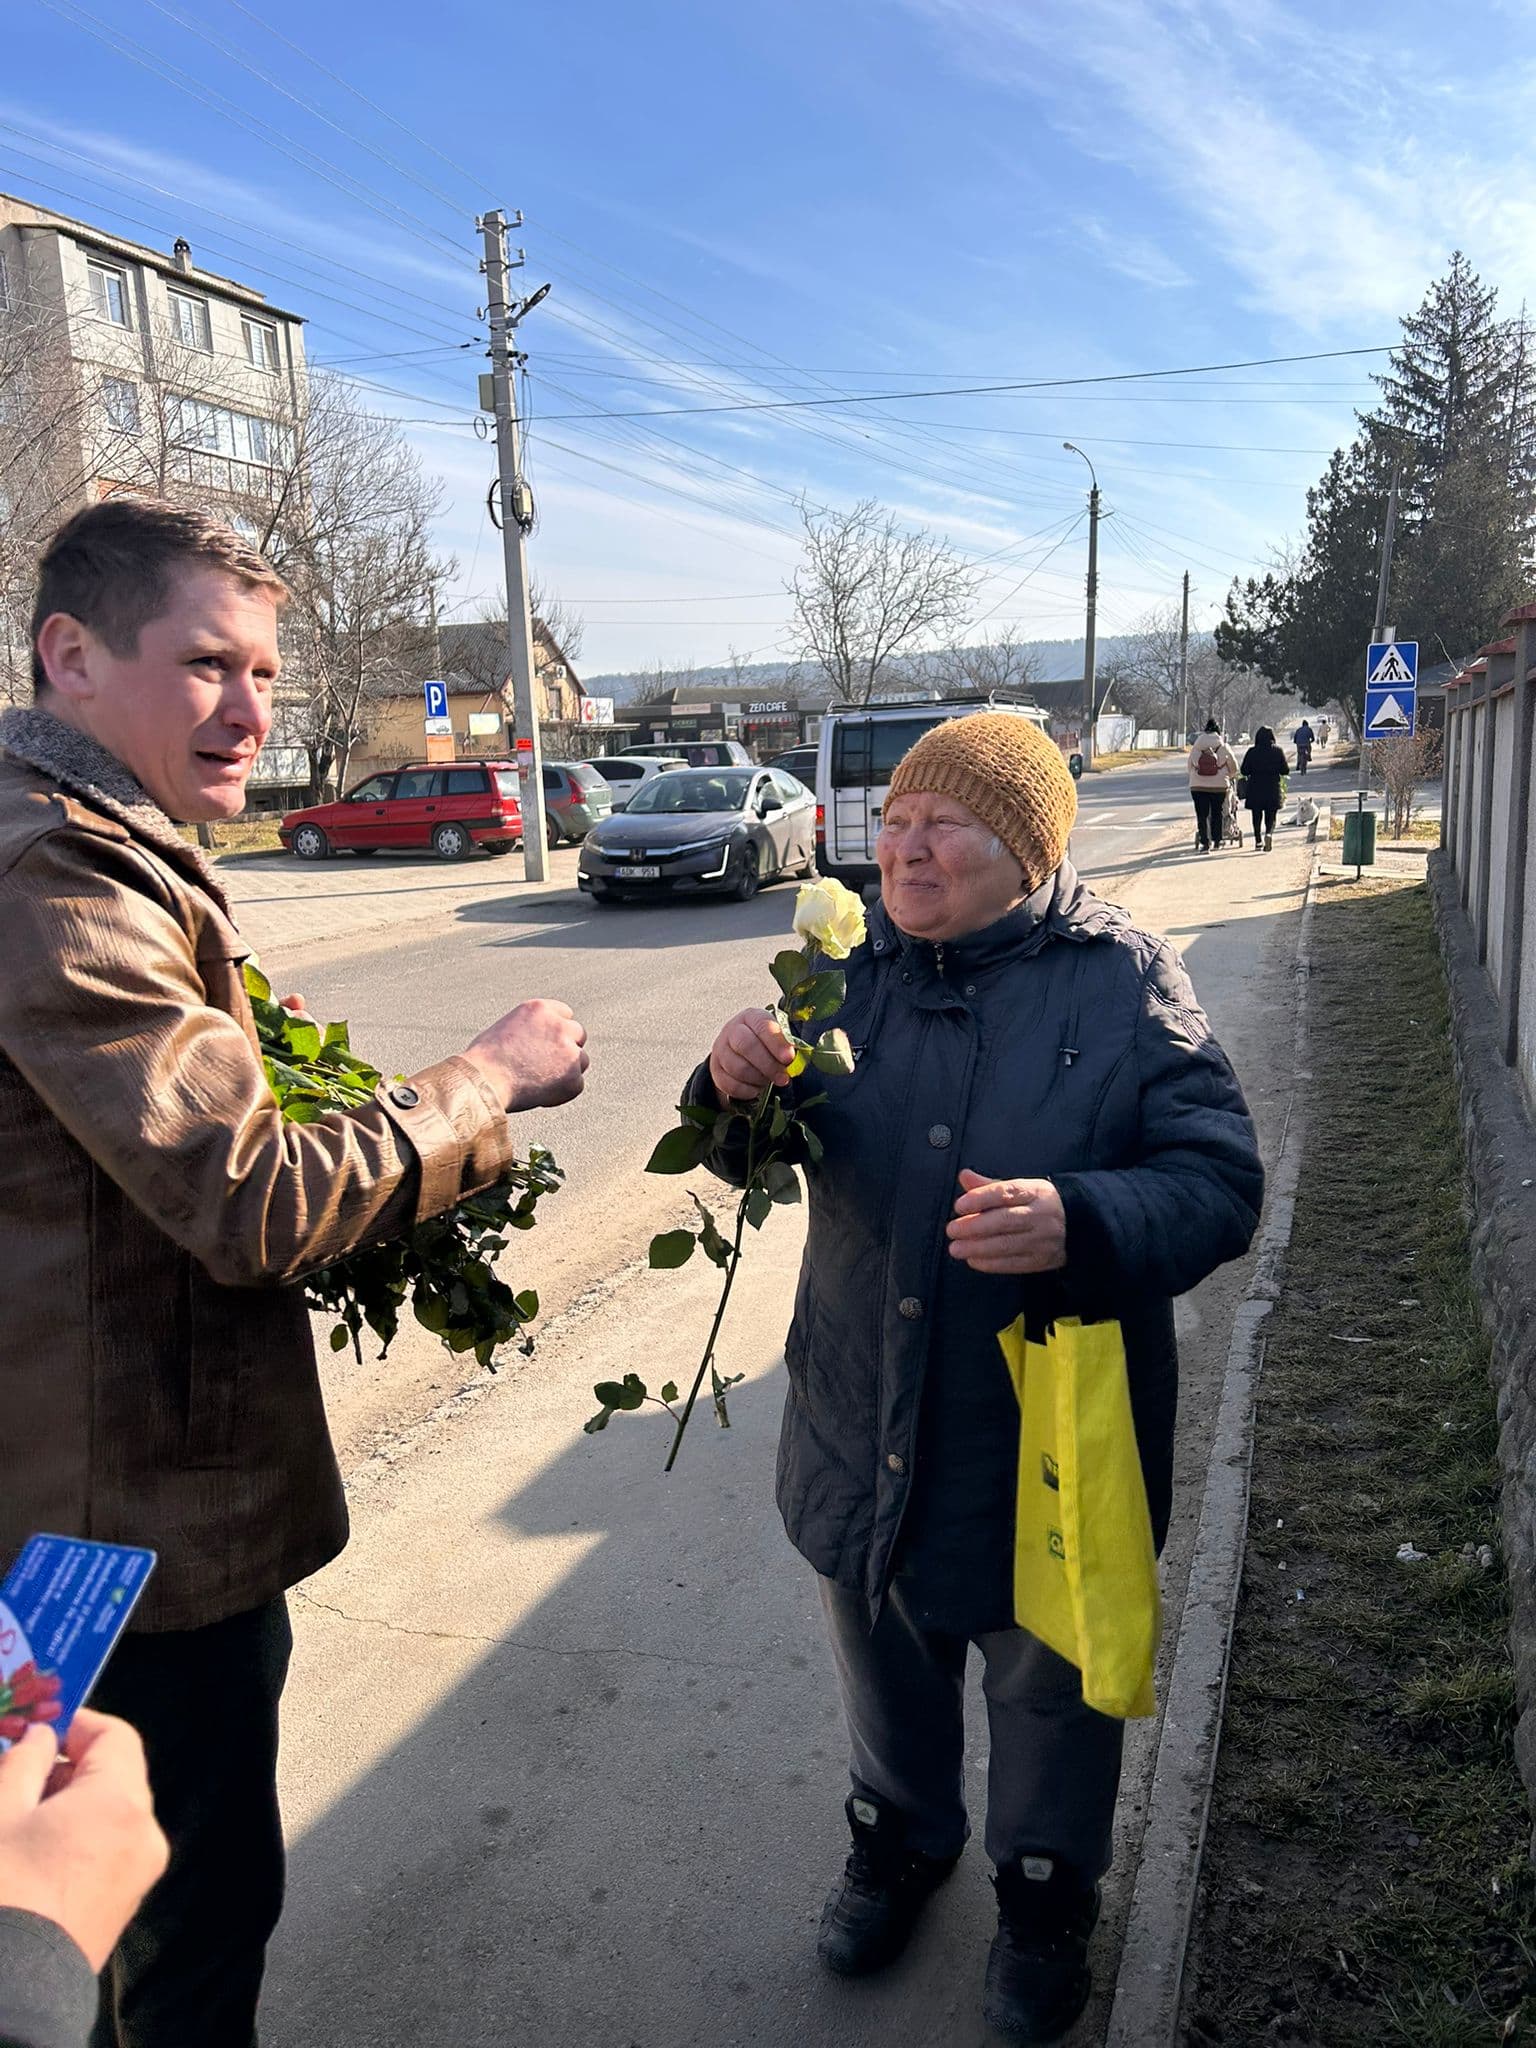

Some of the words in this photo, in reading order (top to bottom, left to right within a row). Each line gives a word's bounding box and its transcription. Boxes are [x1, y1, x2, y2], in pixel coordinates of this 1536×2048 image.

[430, 686, 442, 714] P
[749, 703, 765, 713] ZEN
[766, 701, 787, 712] CAFE
